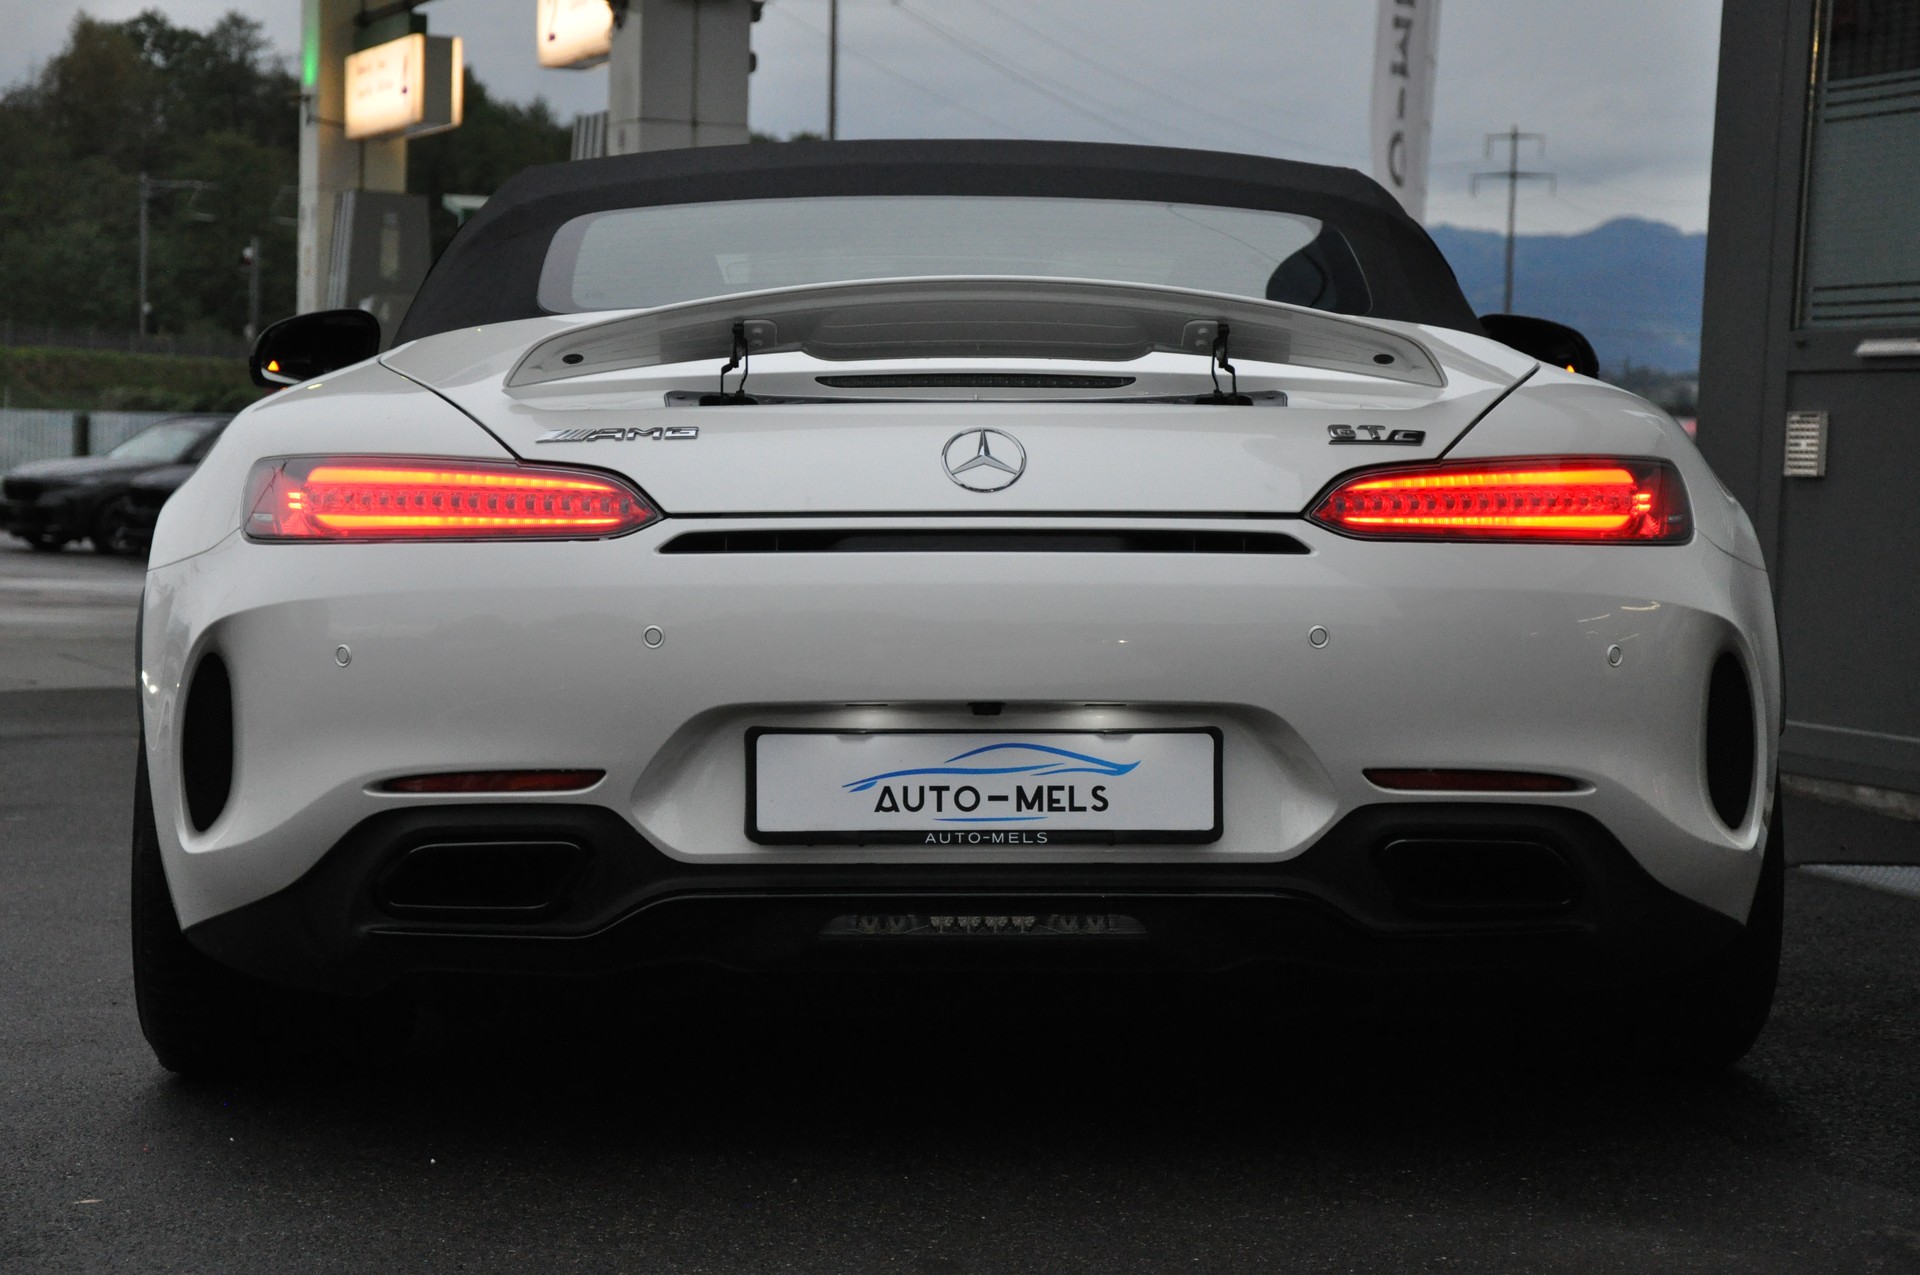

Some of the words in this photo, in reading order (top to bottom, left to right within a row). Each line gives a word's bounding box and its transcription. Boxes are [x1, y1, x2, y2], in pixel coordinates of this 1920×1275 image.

[586, 426, 699, 442] AMG
[874, 785, 1109, 812] AUTO-MELS
[925, 832, 1048, 843] AUTO-MELS
